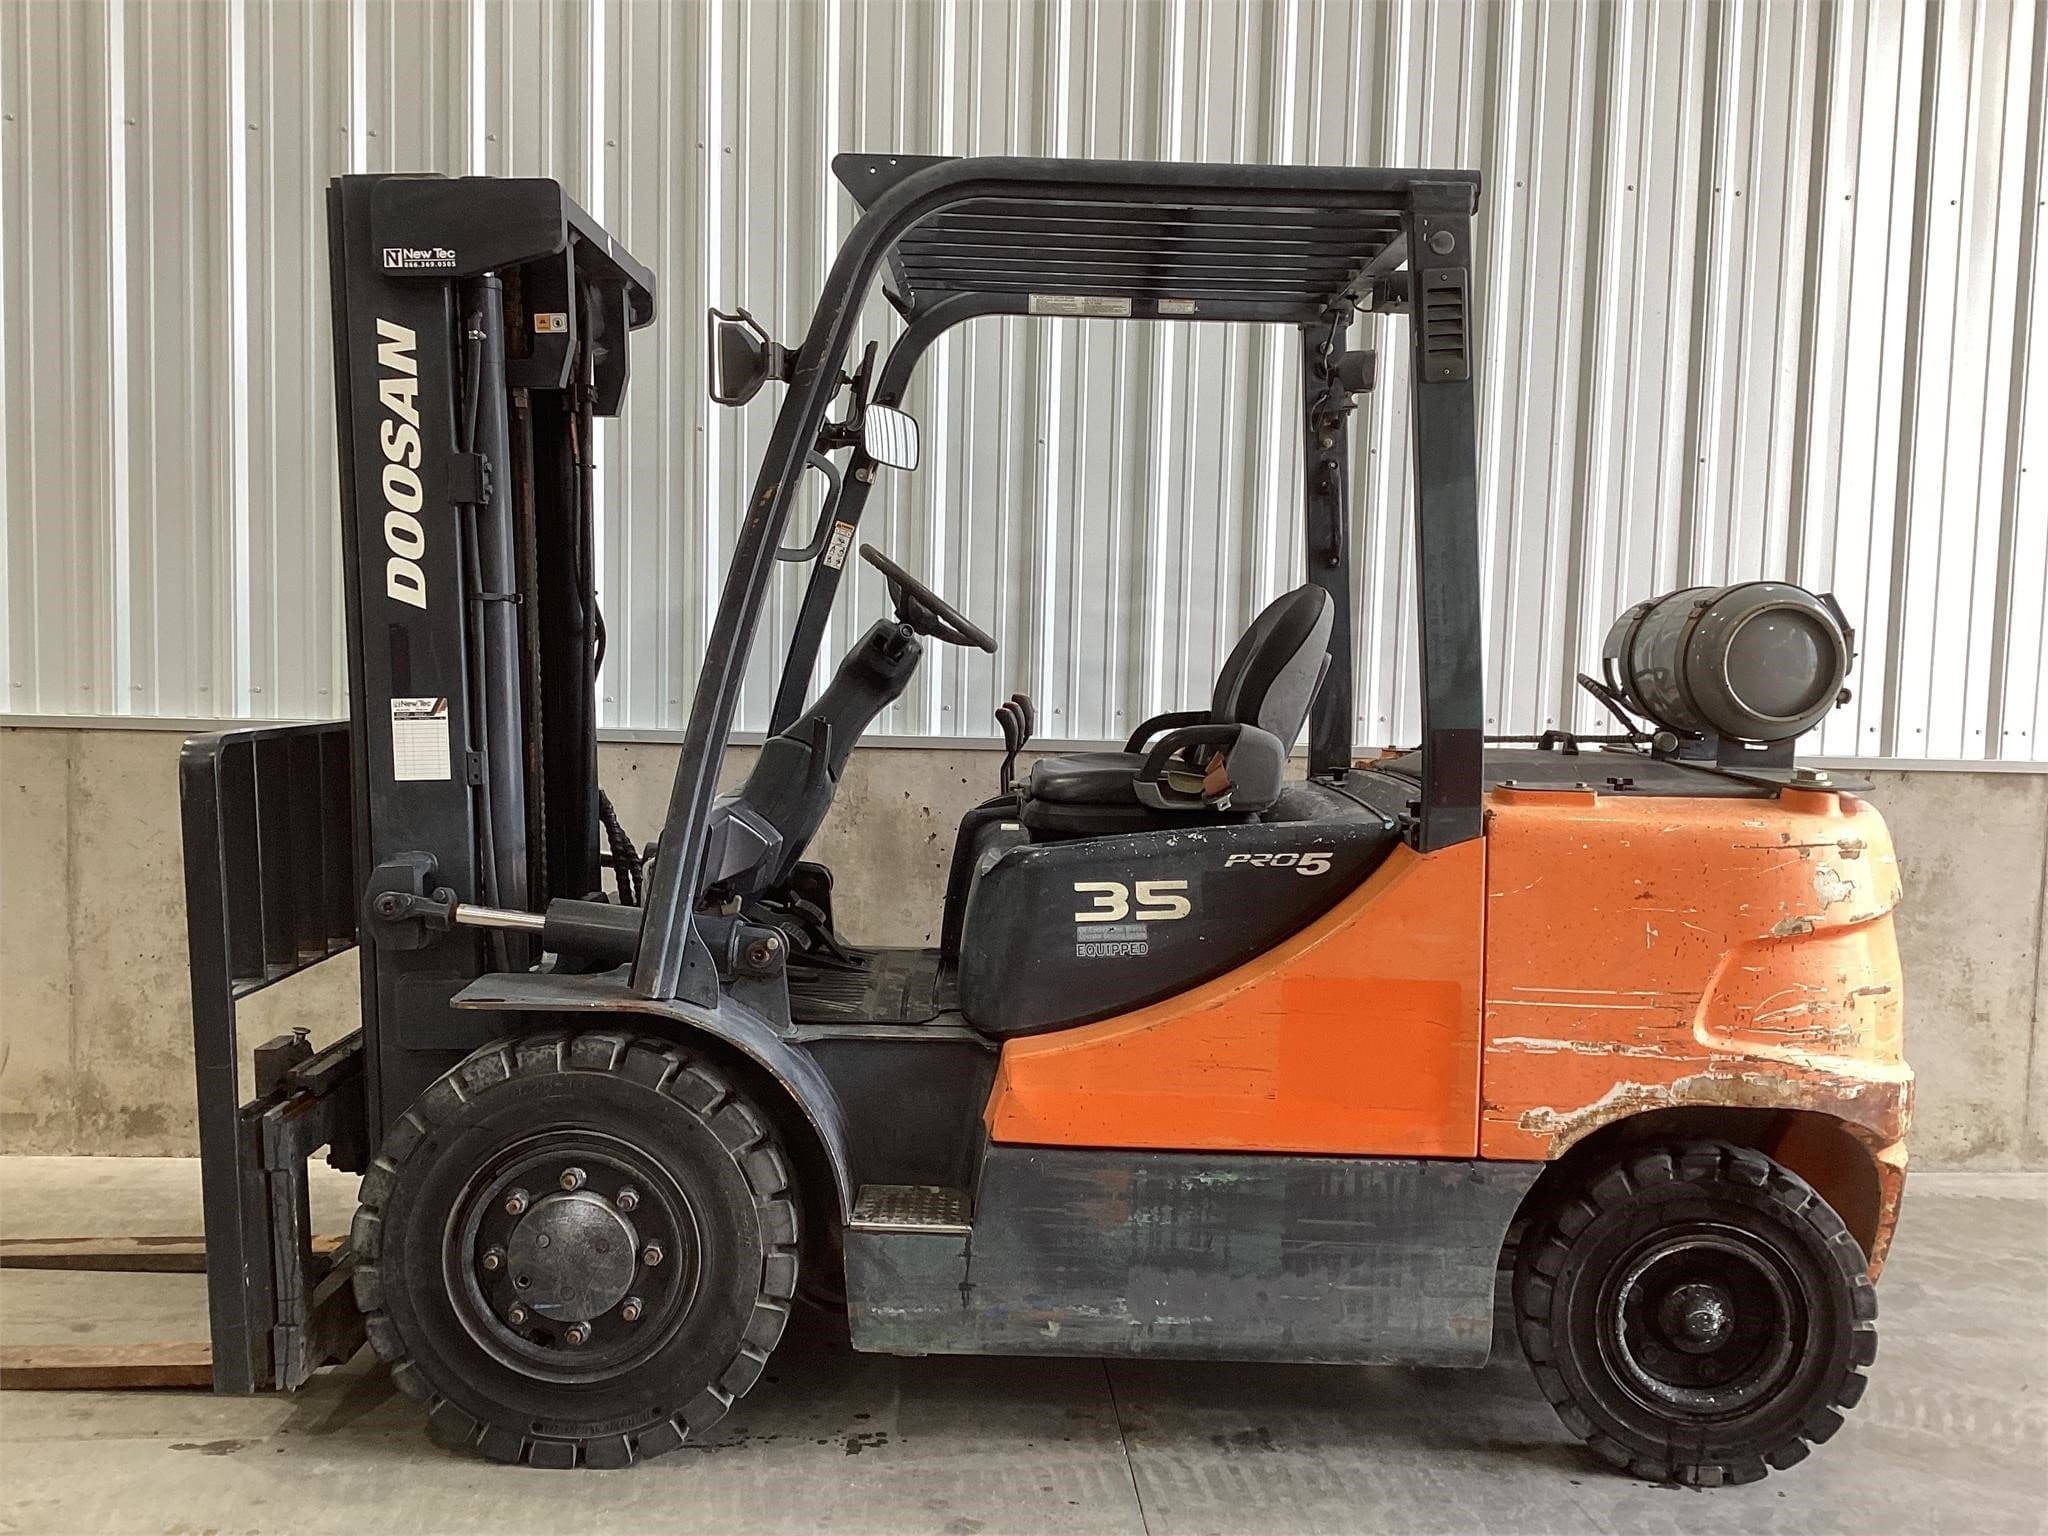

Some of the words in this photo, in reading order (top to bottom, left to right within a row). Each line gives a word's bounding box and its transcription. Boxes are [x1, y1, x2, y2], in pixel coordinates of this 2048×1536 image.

[403, 248, 432, 259] New
[433, 248, 456, 259] Tec
[376, 318, 427, 609] DOOSAN
[1224, 852, 1334, 876] PRO5
[1074, 880, 1192, 922] 35
[1076, 942, 1149, 957] EQUIPPED
